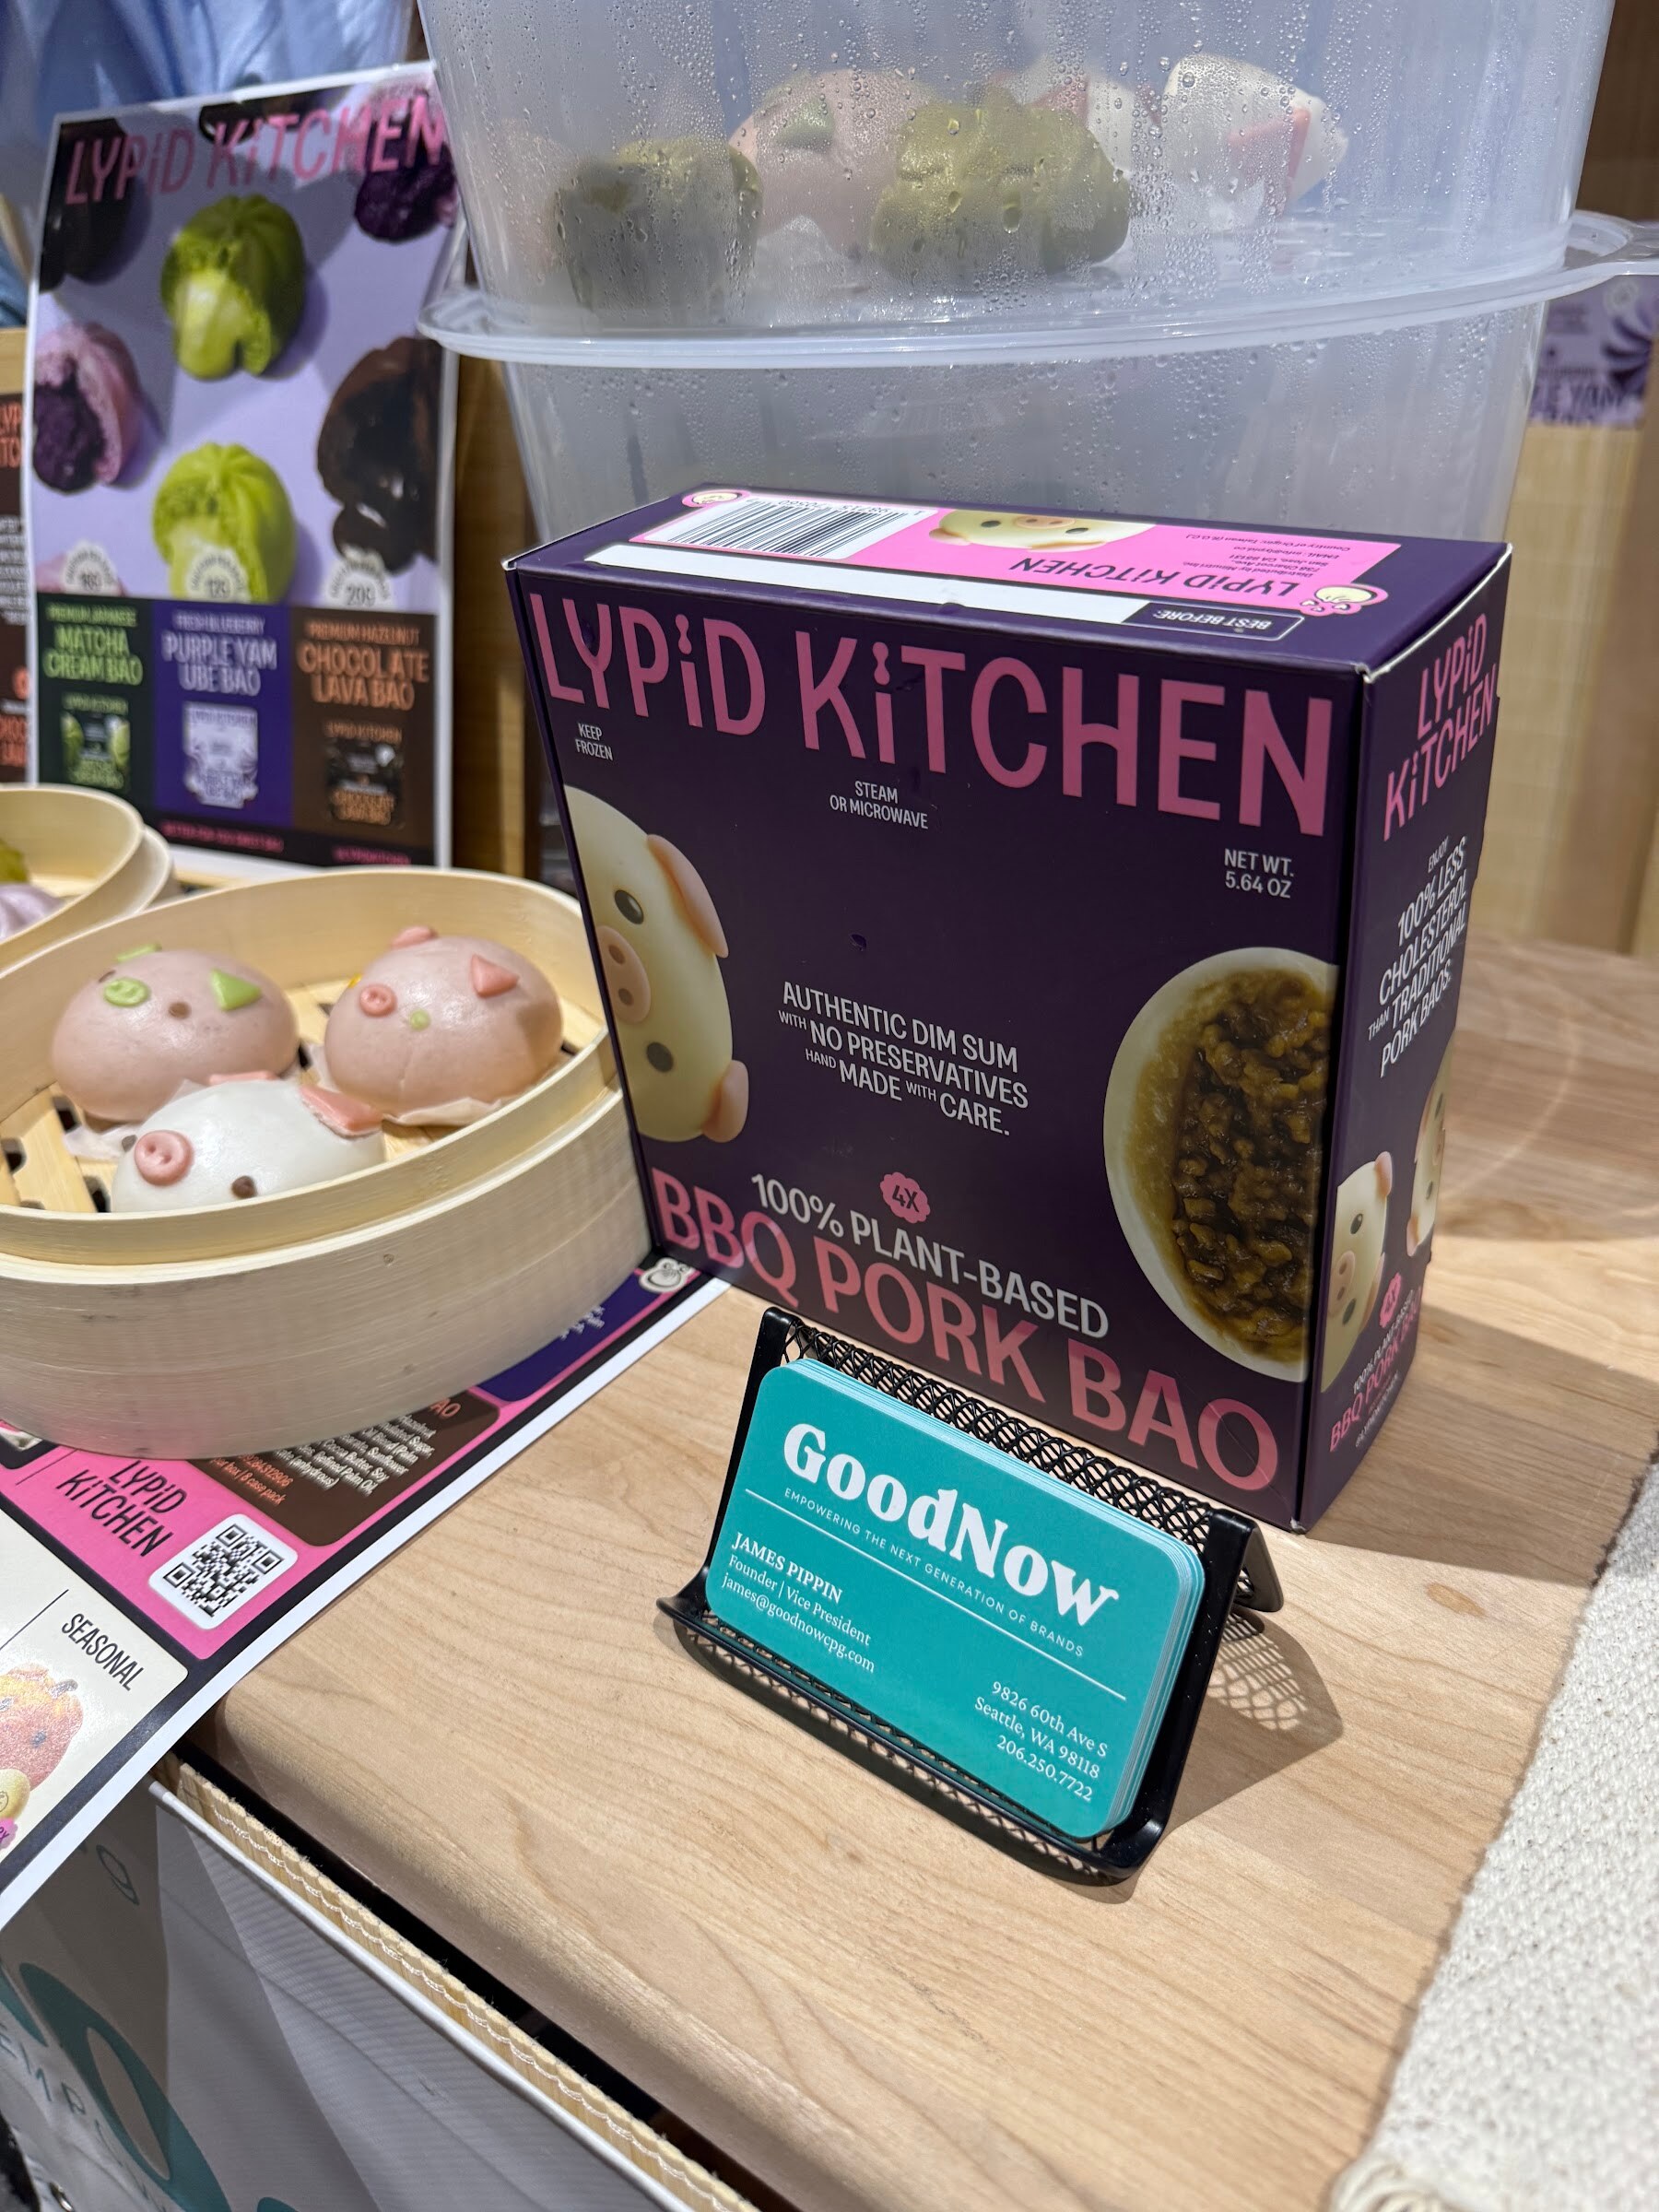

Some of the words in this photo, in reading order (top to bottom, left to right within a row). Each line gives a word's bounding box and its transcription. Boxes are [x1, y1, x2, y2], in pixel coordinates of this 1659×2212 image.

[1251, 567, 1313, 578] Distributed
[54, 624, 129, 656] MATCHA
[1152, 609, 1224, 627] BEFORE:
[1224, 615, 1273, 630] BEST
[43, 649, 103, 680] CREAM
[104, 655, 143, 685] BAO
[161, 629, 233, 665] PURPLE
[234, 636, 277, 670] YAM
[297, 641, 429, 682] CHOCOLATE
[178, 664, 218, 691] UBE
[220, 666, 262, 696] BAO
[312, 674, 370, 706] LAVA
[371, 678, 415, 711] BAO
[575, 738, 614, 762] FROZEN
[578, 723, 602, 741] KEEP
[830, 794, 847, 812] OR
[849, 799, 928, 830] MICROWAVE
[854, 781, 898, 805] STEAM
[1224, 848, 1259, 871] NET
[1262, 854, 1295, 877] WT.
[1427, 835, 1450, 874] ENJOY
[1225, 870, 1264, 894] 5.64
[1267, 877, 1292, 899] OZ
[1397, 875, 1436, 947] 100%
[1436, 835, 1468, 899] LESS
[1379, 868, 1468, 1006] CHOLESTEROL
[1368, 1006, 1390, 1041] THAN
[1392, 900, 1467, 1030] TRADITIONAL
[783, 981, 907, 1040] AUTHENTIC
[912, 1018, 957, 1055] DIM
[962, 1032, 1018, 1073] SUM
[1380, 1005, 1420, 1079] PORK
[778, 1009, 807, 1030] WITH
[809, 1019, 842, 1052] NO
[847, 1030, 1030, 1109] PRESERVATIVES
[805, 1048, 837, 1069] HAND
[839, 1059, 903, 1101] MADE
[905, 1080, 937, 1102] WITH
[939, 1092, 1010, 1136] CARE.
[888, 1182, 922, 1214] 4X
[751, 1173, 843, 1239] 100%
[851, 1209, 1109, 1339] PLANT-BASED
[652, 1166, 800, 1309] BBQ
[814, 1235, 1048, 1405] PORK
[1066, 1338, 1278, 1491] BAO
[1329, 1392, 1363, 1453] BBQ
[1365, 1341, 1399, 1405] PORK
[288, 1455, 340, 1489] (anhydrous)
[313, 1451, 348, 1475] Refined
[340, 1465, 364, 1487] Palm
[323, 1439, 349, 1458] Cocoa
[371, 1467, 390, 1483] Soy
[367, 1446, 409, 1476] Sunflower
[224, 1462, 241, 1477] box
[246, 1477, 267, 1492] case
[260, 1488, 287, 1506] pack
[783, 1423, 1120, 1626] GoodNow
[731, 1532, 786, 1571] JAMES
[786, 1560, 842, 1604] PIPPIN
[784, 1488, 860, 1535] EMPOWERING
[865, 1529, 886, 1548] THE
[889, 1546, 922, 1567] NEXT
[924, 1563, 1005, 1614] GENERATION
[1008, 1609, 1026, 1624] OF
[1030, 1620, 1084, 1656] BRANDS
[728, 1554, 778, 1591] Founder
[786, 1586, 811, 1610] Vice
[812, 1602, 871, 1646] President
[722, 1572, 875, 1673] james@goodnowcpg.com
[61, 1613, 145, 1692] SEASONAL
[974, 1696, 1025, 1739] Seattle,
[1030, 1726, 1055, 1755] WA
[1058, 1746, 1100, 1779] 98118
[992, 1681, 1028, 1712] 9826
[1030, 1705, 1065, 1735] 60th
[1066, 1726, 1095, 1750] Ave
[1097, 1742, 1108, 1758] S
[996, 1735, 1093, 1803] 206.250.7722
